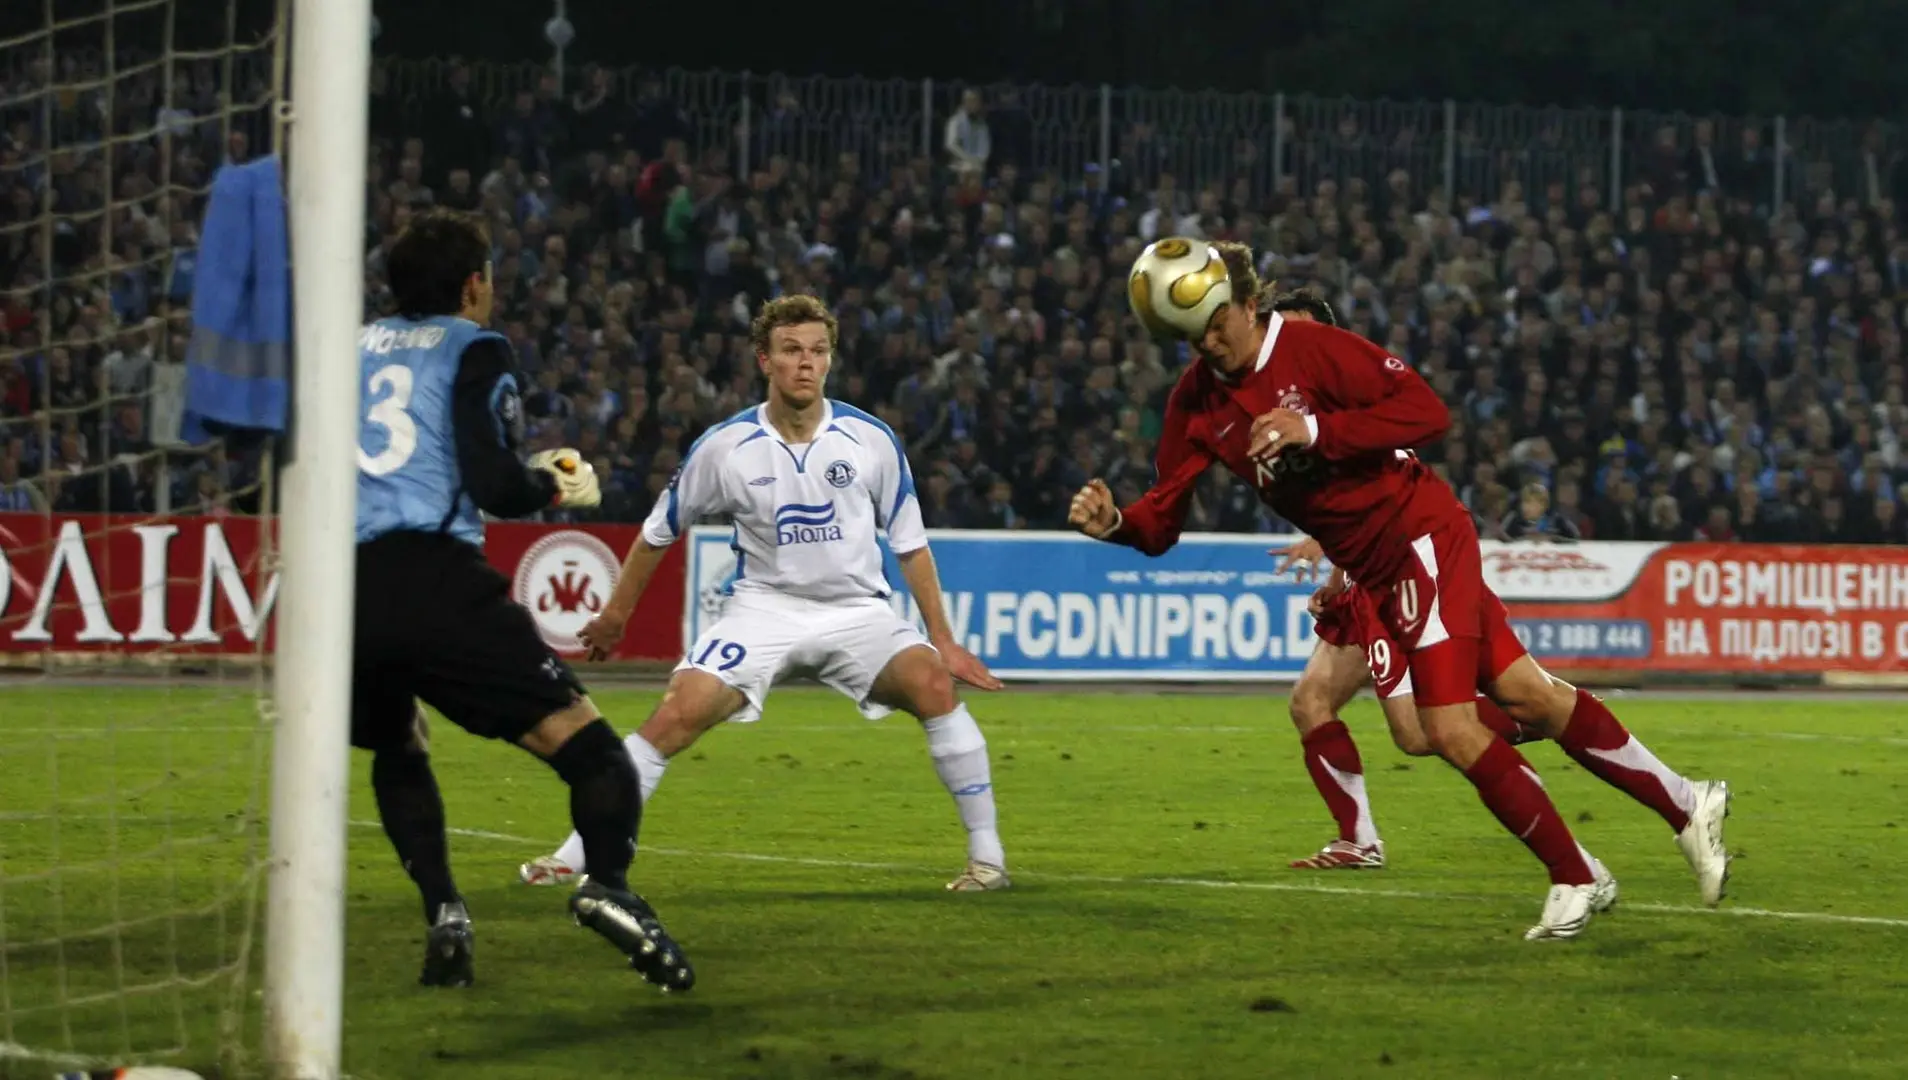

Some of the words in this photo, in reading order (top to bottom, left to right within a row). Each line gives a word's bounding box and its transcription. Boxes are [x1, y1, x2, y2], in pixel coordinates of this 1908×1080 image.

[695, 638, 748, 671] 19
[1664, 617, 1710, 656] НА
[1720, 617, 1852, 661] ПІДЛОЗІ
[1860, 619, 1885, 659] В
